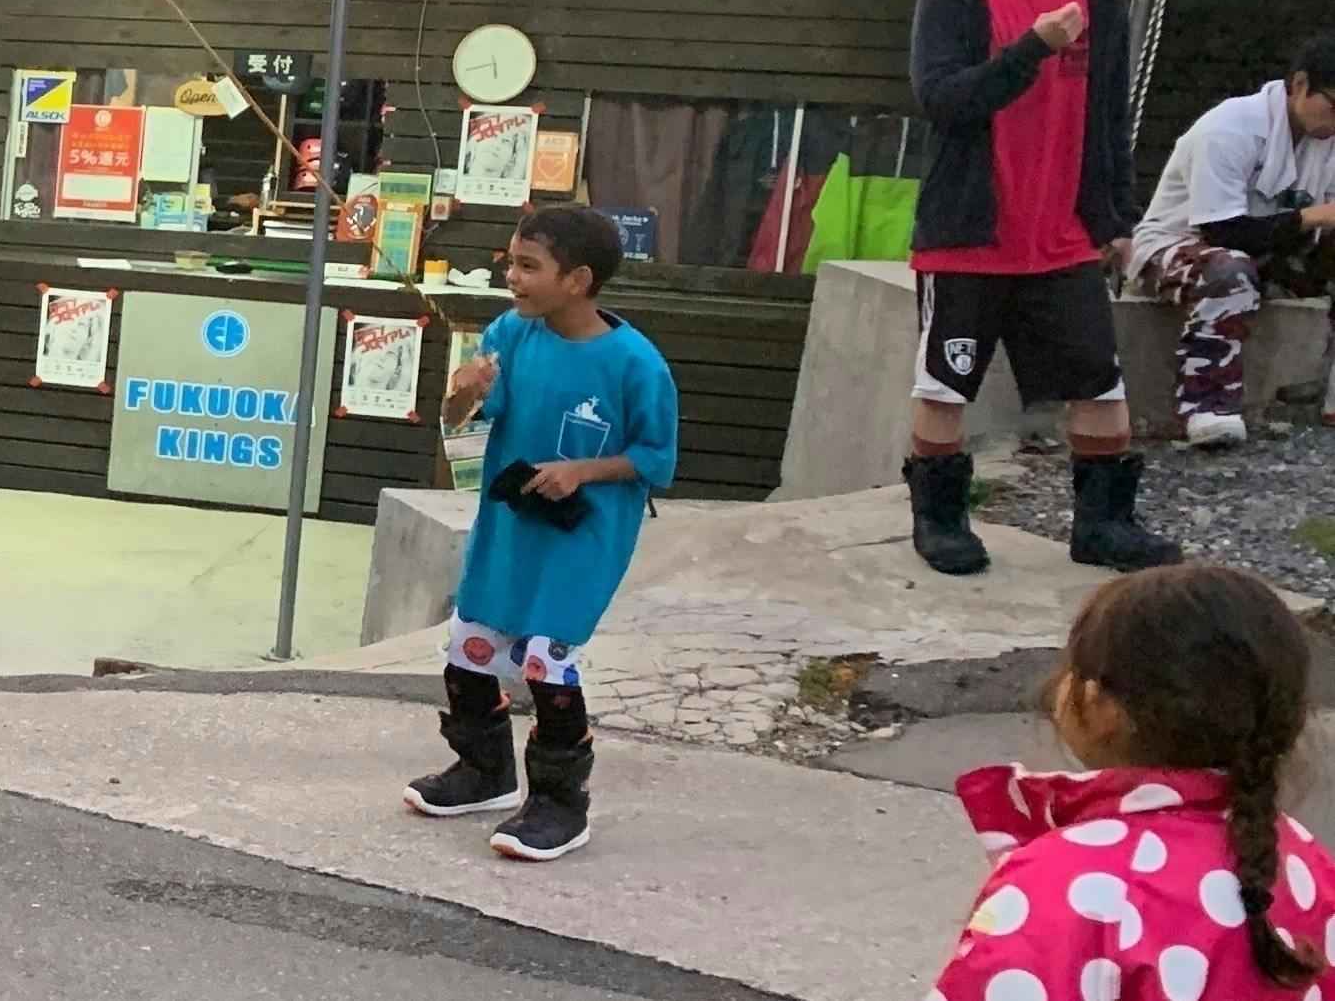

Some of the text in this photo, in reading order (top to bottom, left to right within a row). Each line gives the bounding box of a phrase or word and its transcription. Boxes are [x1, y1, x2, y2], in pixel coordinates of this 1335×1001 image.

[248, 54, 293, 74] 受付
[180, 88, 217, 105] Open
[26, 111, 66, 120] ALSOK
[156, 425, 283, 470] KINGS
